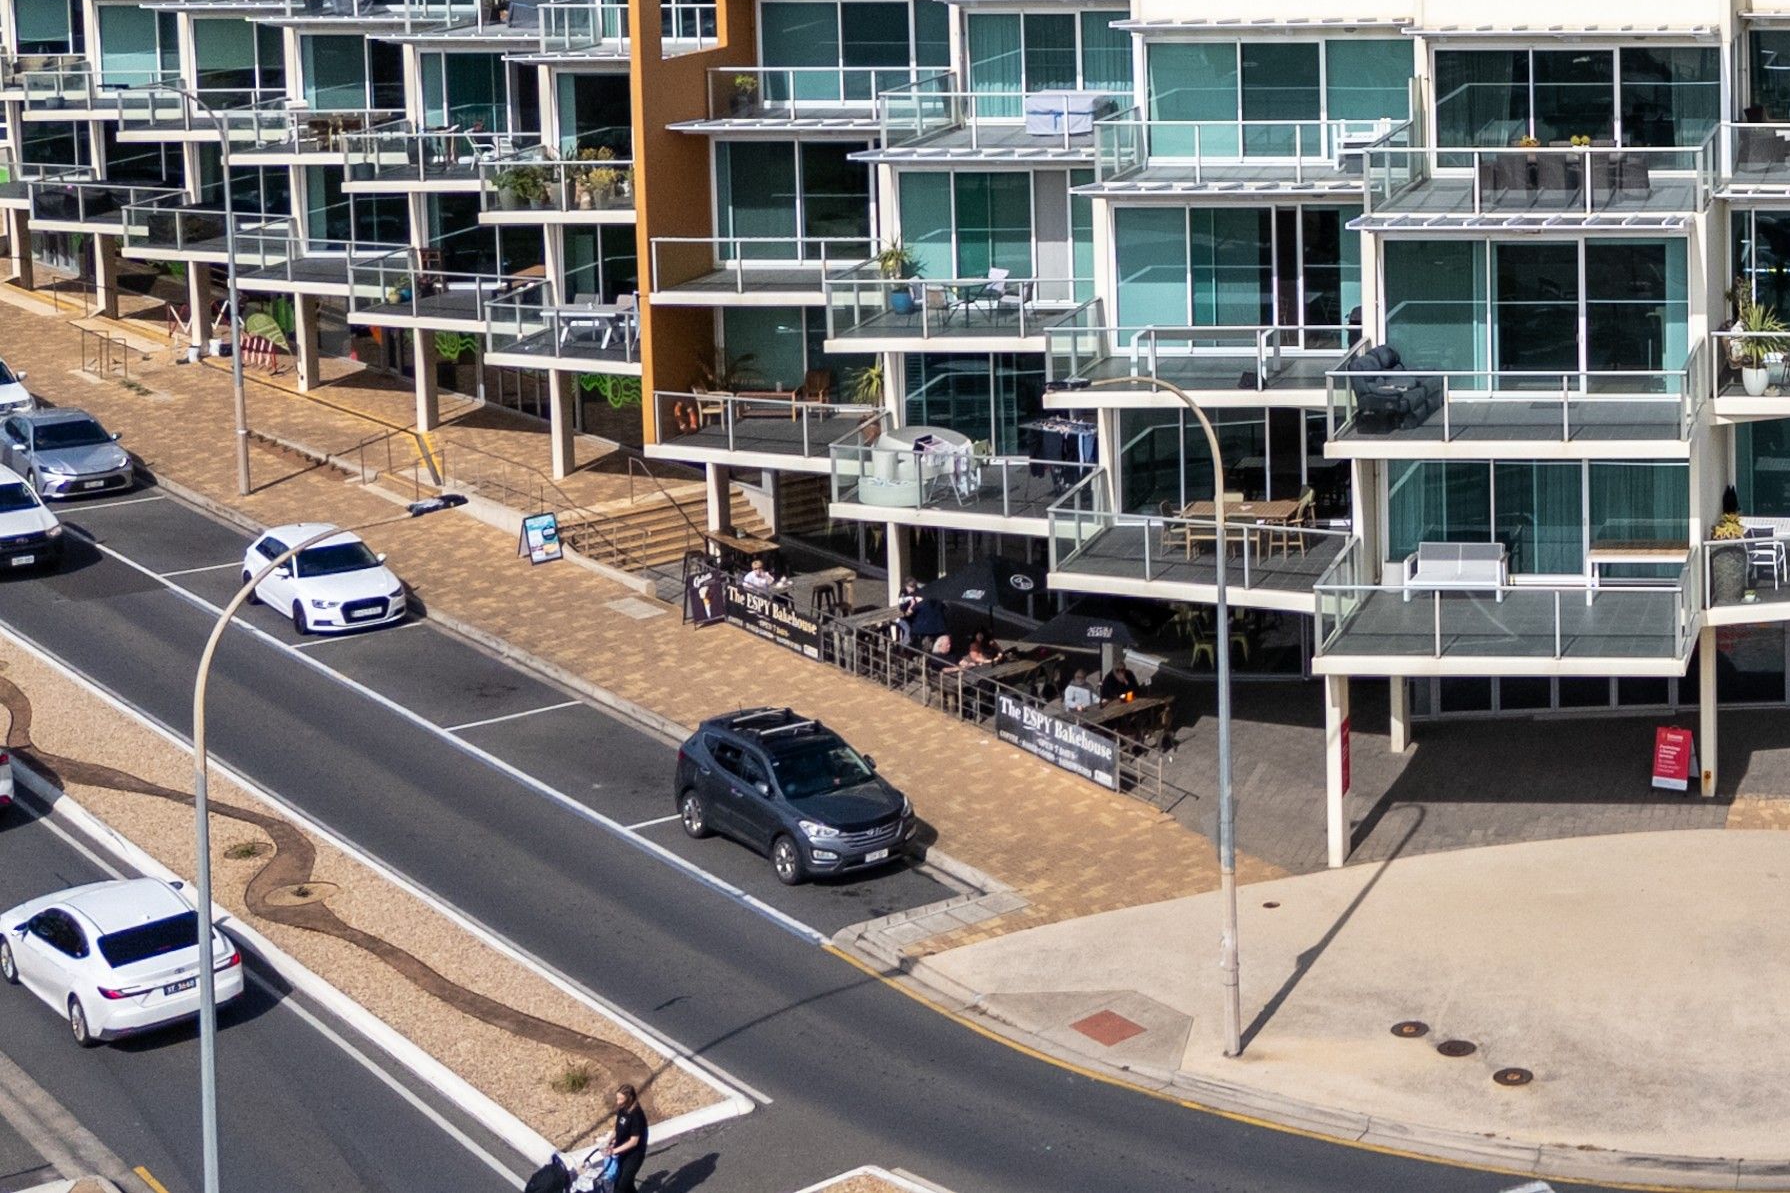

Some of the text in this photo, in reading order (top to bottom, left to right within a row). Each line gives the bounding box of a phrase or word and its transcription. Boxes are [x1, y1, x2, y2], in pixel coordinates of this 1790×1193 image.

[728, 586, 745, 605] The
[746, 592, 771, 615] ESPY
[772, 603, 818, 635] Bakehouse
[999, 695, 1021, 720] The
[1022, 706, 1052, 734] ESPY
[1055, 721, 1112, 759] Bakehouse
